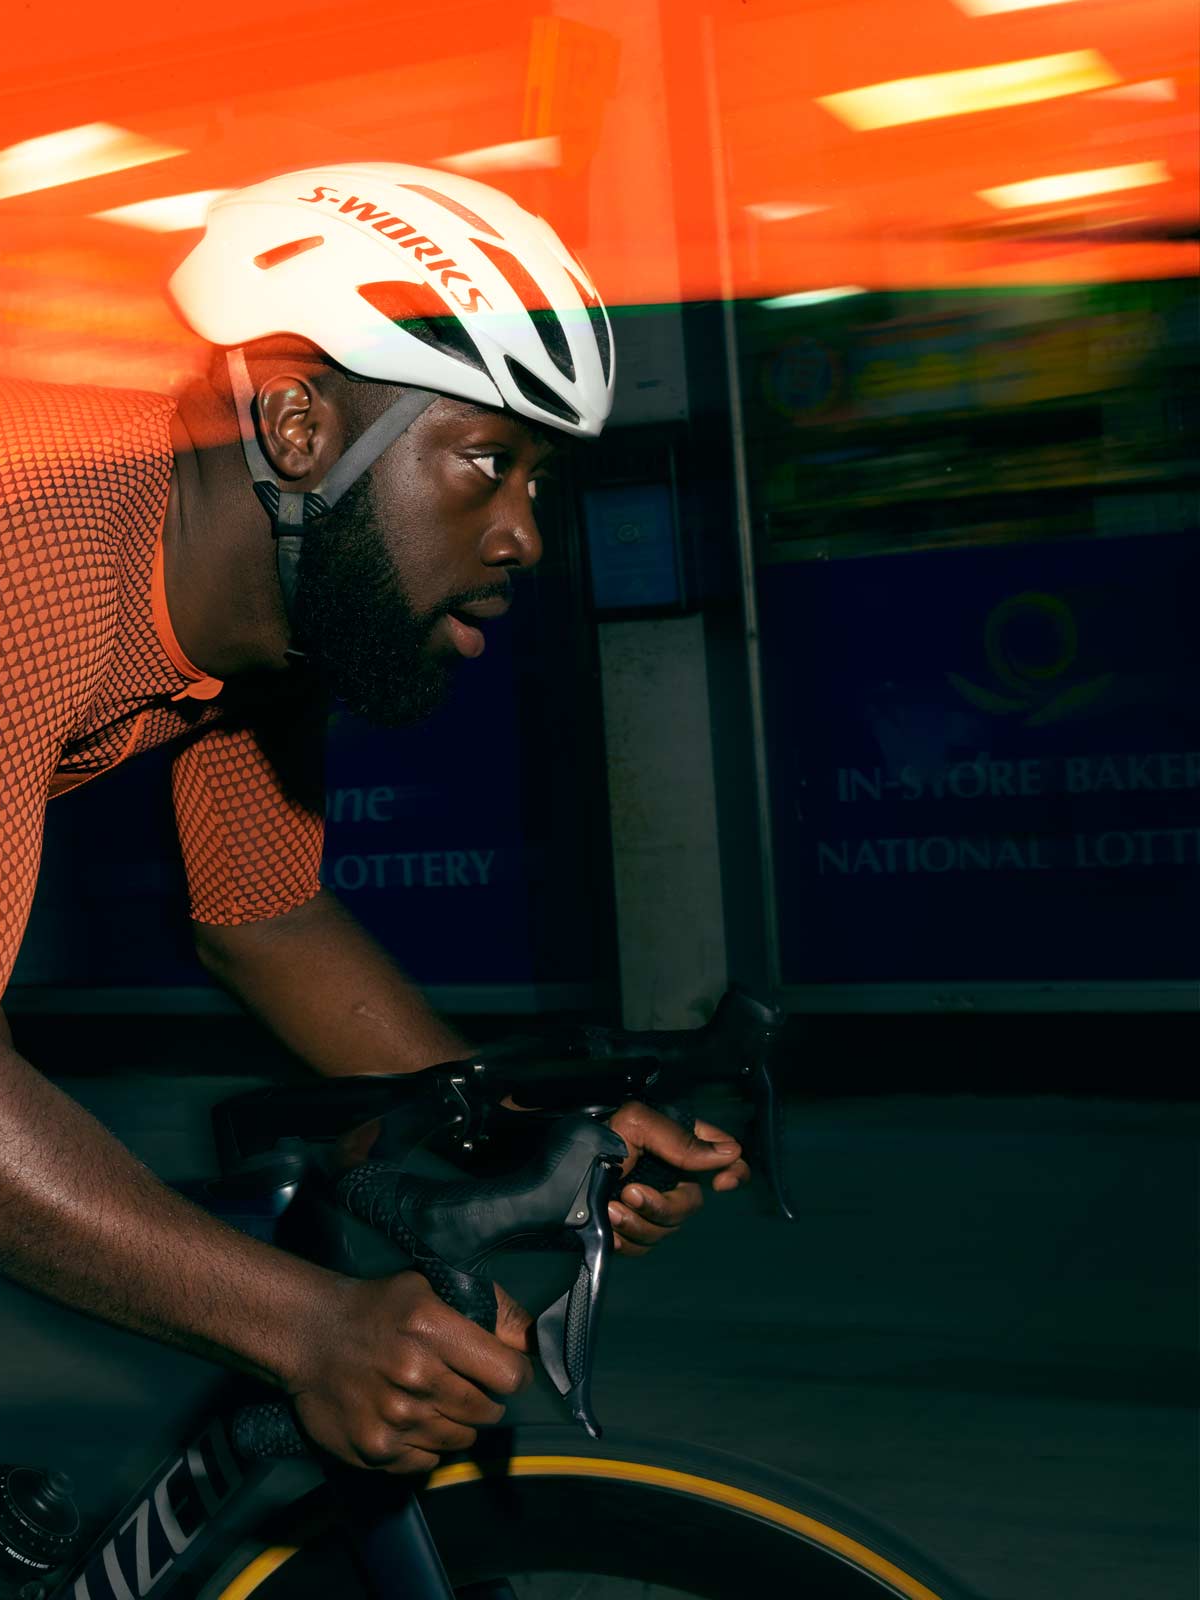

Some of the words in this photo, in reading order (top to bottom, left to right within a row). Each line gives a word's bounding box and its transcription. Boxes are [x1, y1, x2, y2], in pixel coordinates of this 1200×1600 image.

[297, 186, 494, 314] S-WORKS
[325, 785, 395, 823] ne
[817, 834, 1054, 876] NATIONAL
[1073, 827, 1200, 870] LOTT
